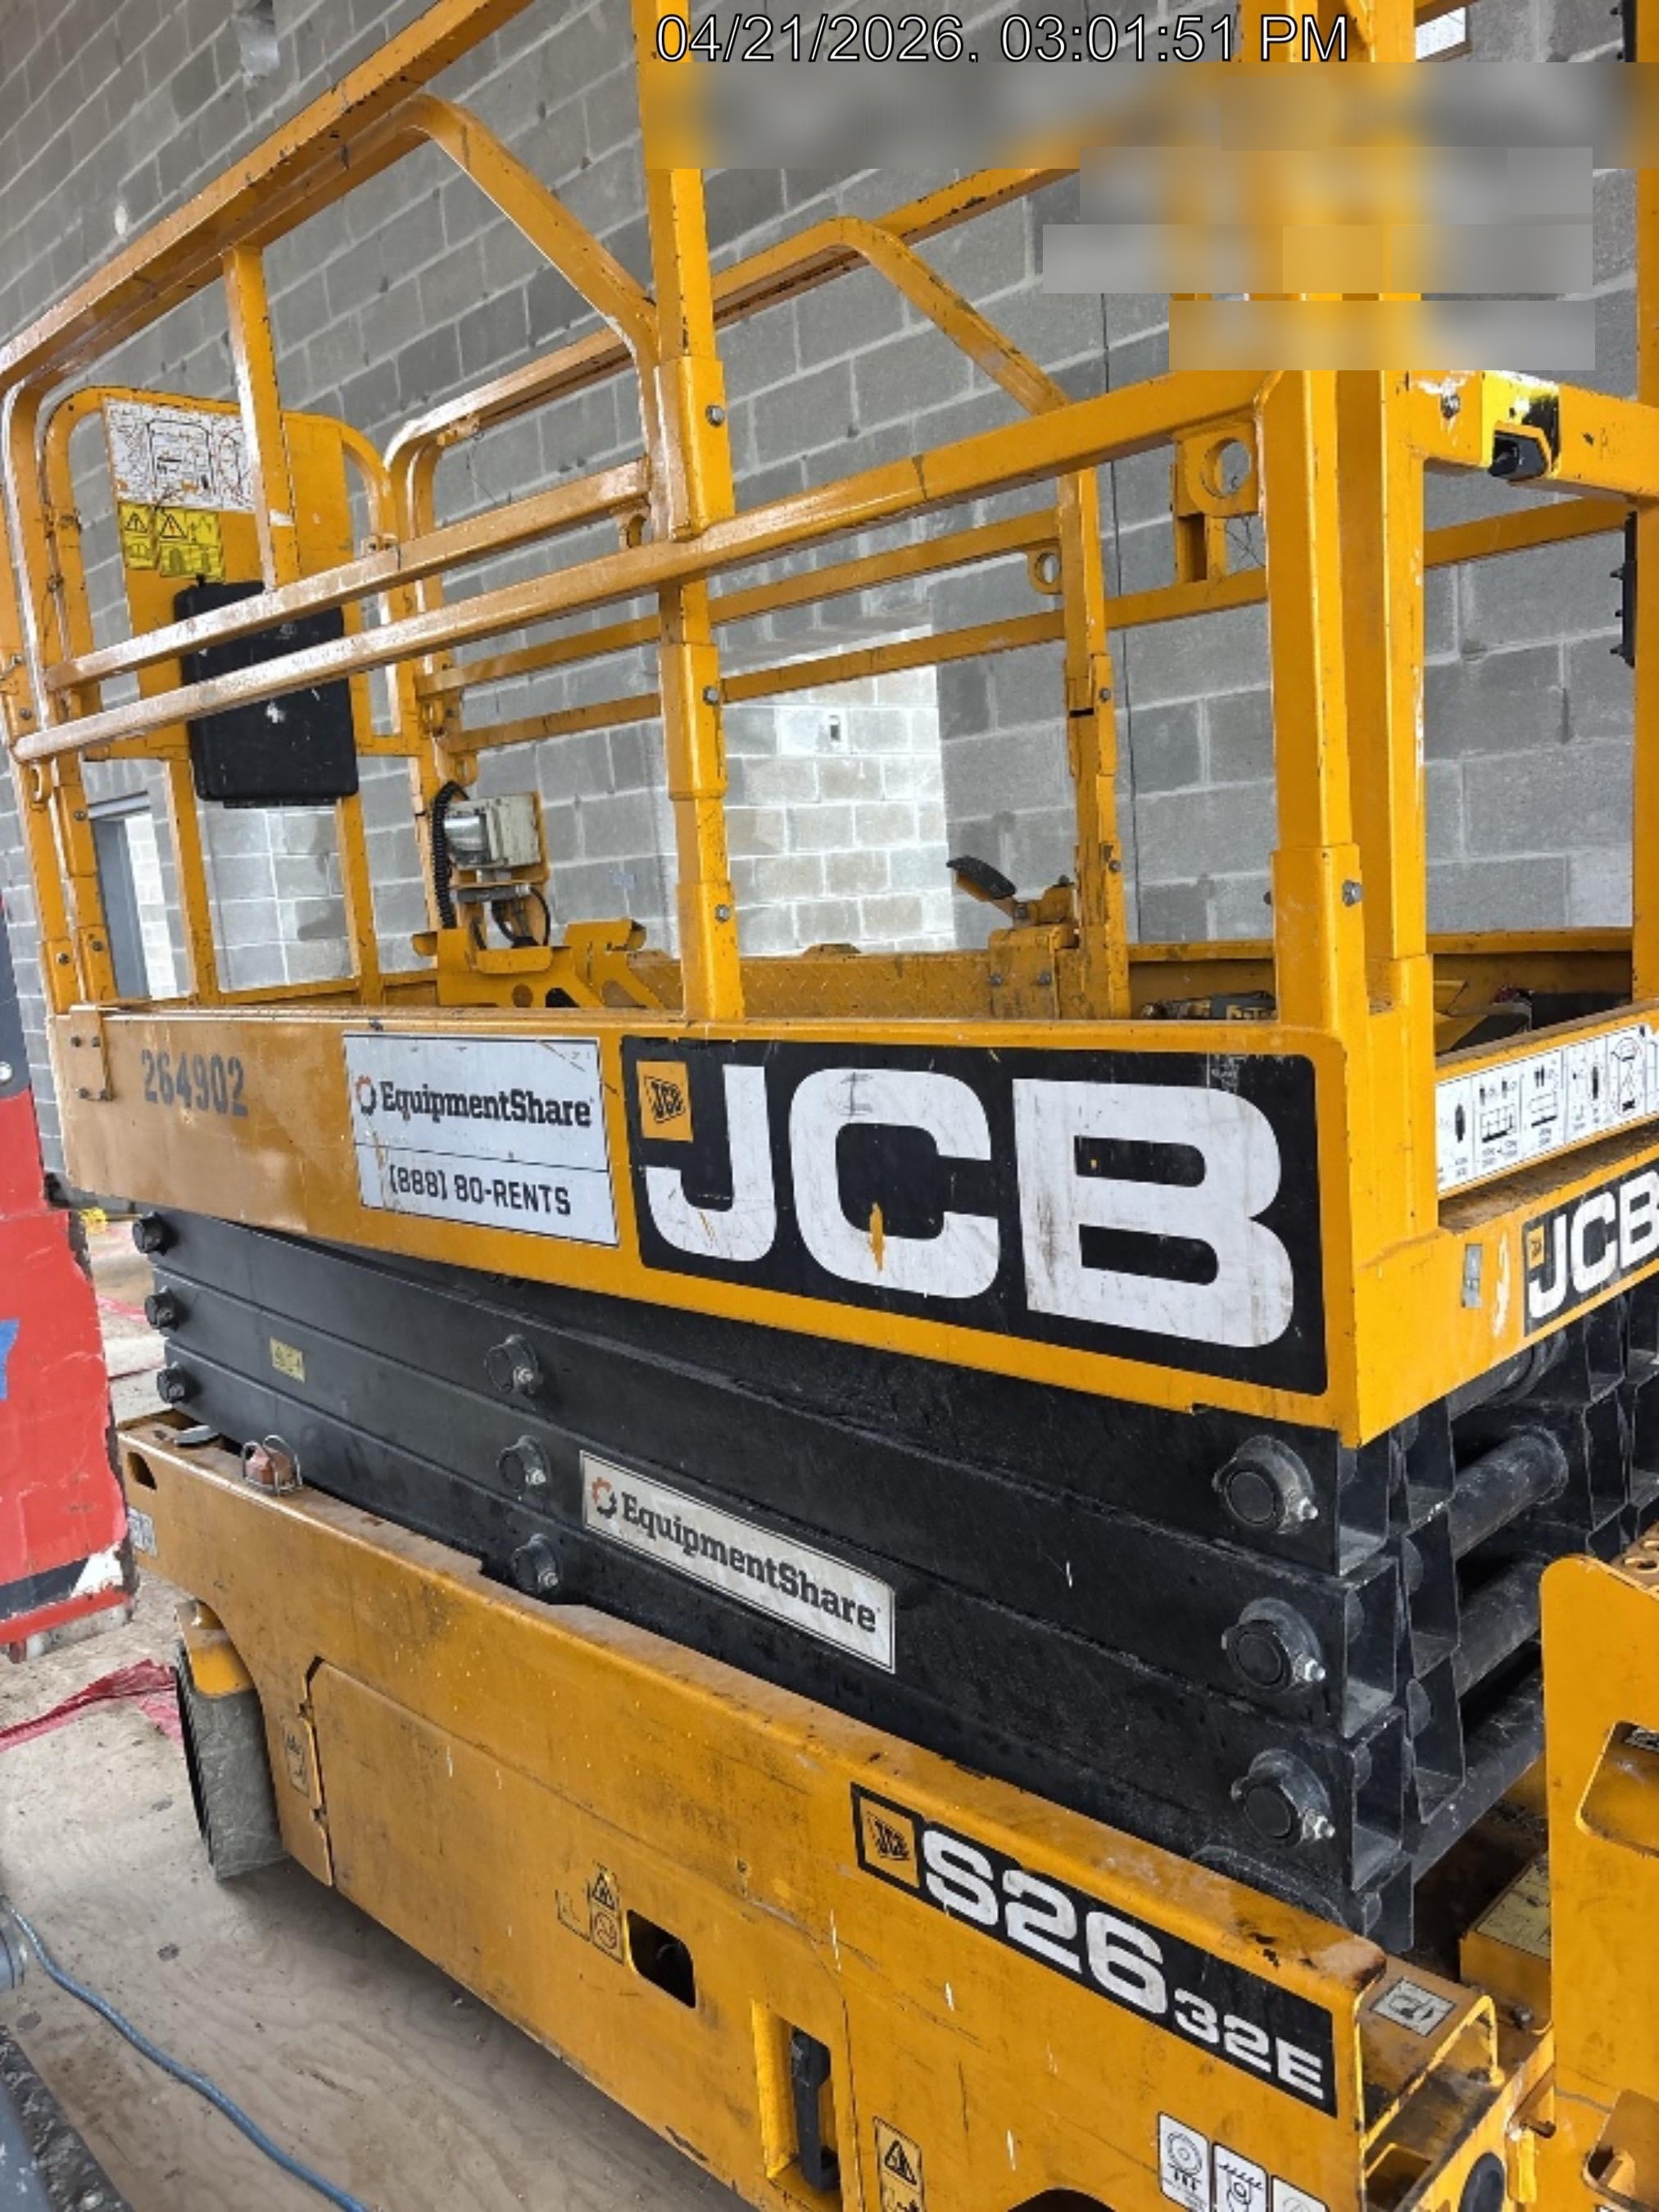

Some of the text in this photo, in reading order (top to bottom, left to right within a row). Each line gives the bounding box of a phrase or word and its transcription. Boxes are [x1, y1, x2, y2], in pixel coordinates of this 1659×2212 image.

[141, 1048, 248, 1117] 264902
[379, 1080, 592, 1128] EquipmentShare
[389, 1164, 571, 1216] (888) 80-RENTS
[643, 1063, 1294, 1348] JCB
[1529, 1170, 1659, 1318] JCB
[622, 1491, 876, 1632] EquipmentShare
